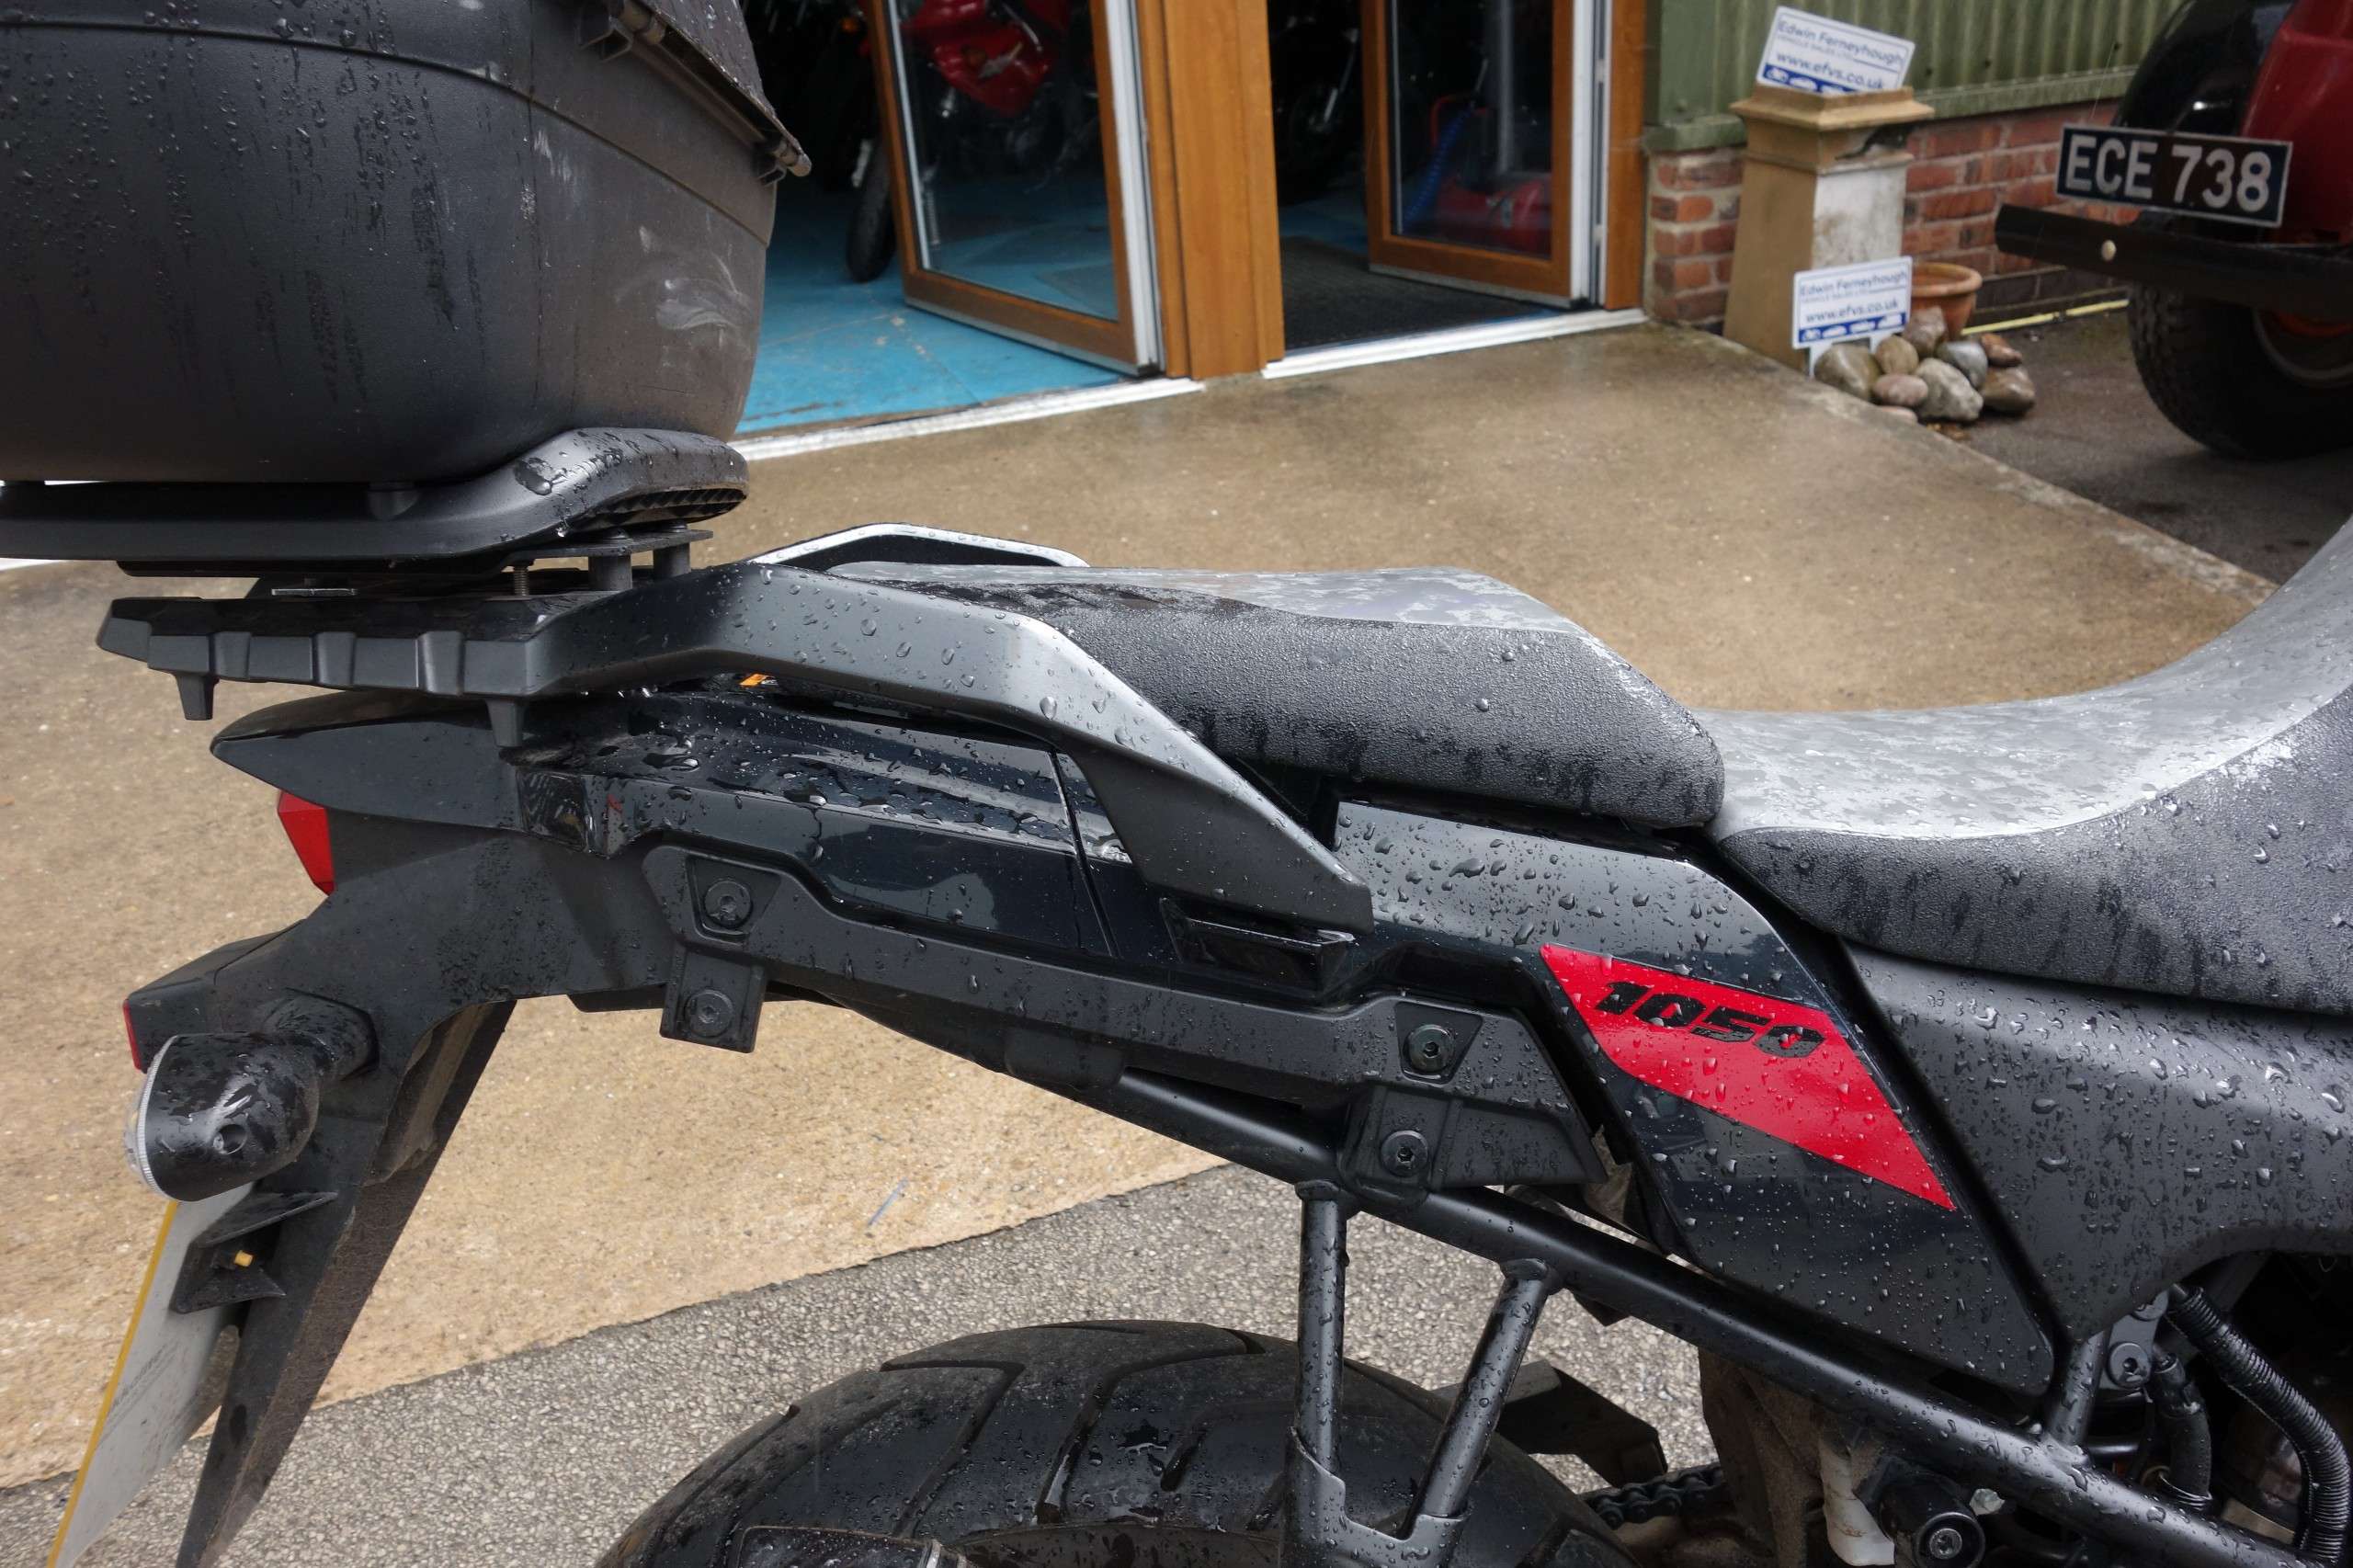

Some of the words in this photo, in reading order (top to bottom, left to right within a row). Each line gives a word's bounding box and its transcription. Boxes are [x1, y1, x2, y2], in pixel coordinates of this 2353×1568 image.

[1778, 20, 1816, 40] Edwin
[1819, 31, 1904, 65] Ferneyhough
[1777, 52, 1883, 89] www.efvs.co.uk
[2065, 133, 2158, 199] ECE
[2170, 144, 2272, 212] 738
[1800, 282, 1835, 295] Edwin
[1806, 298, 1898, 322] www.efvs.co.uk
[1595, 981, 1826, 1058] 1050
